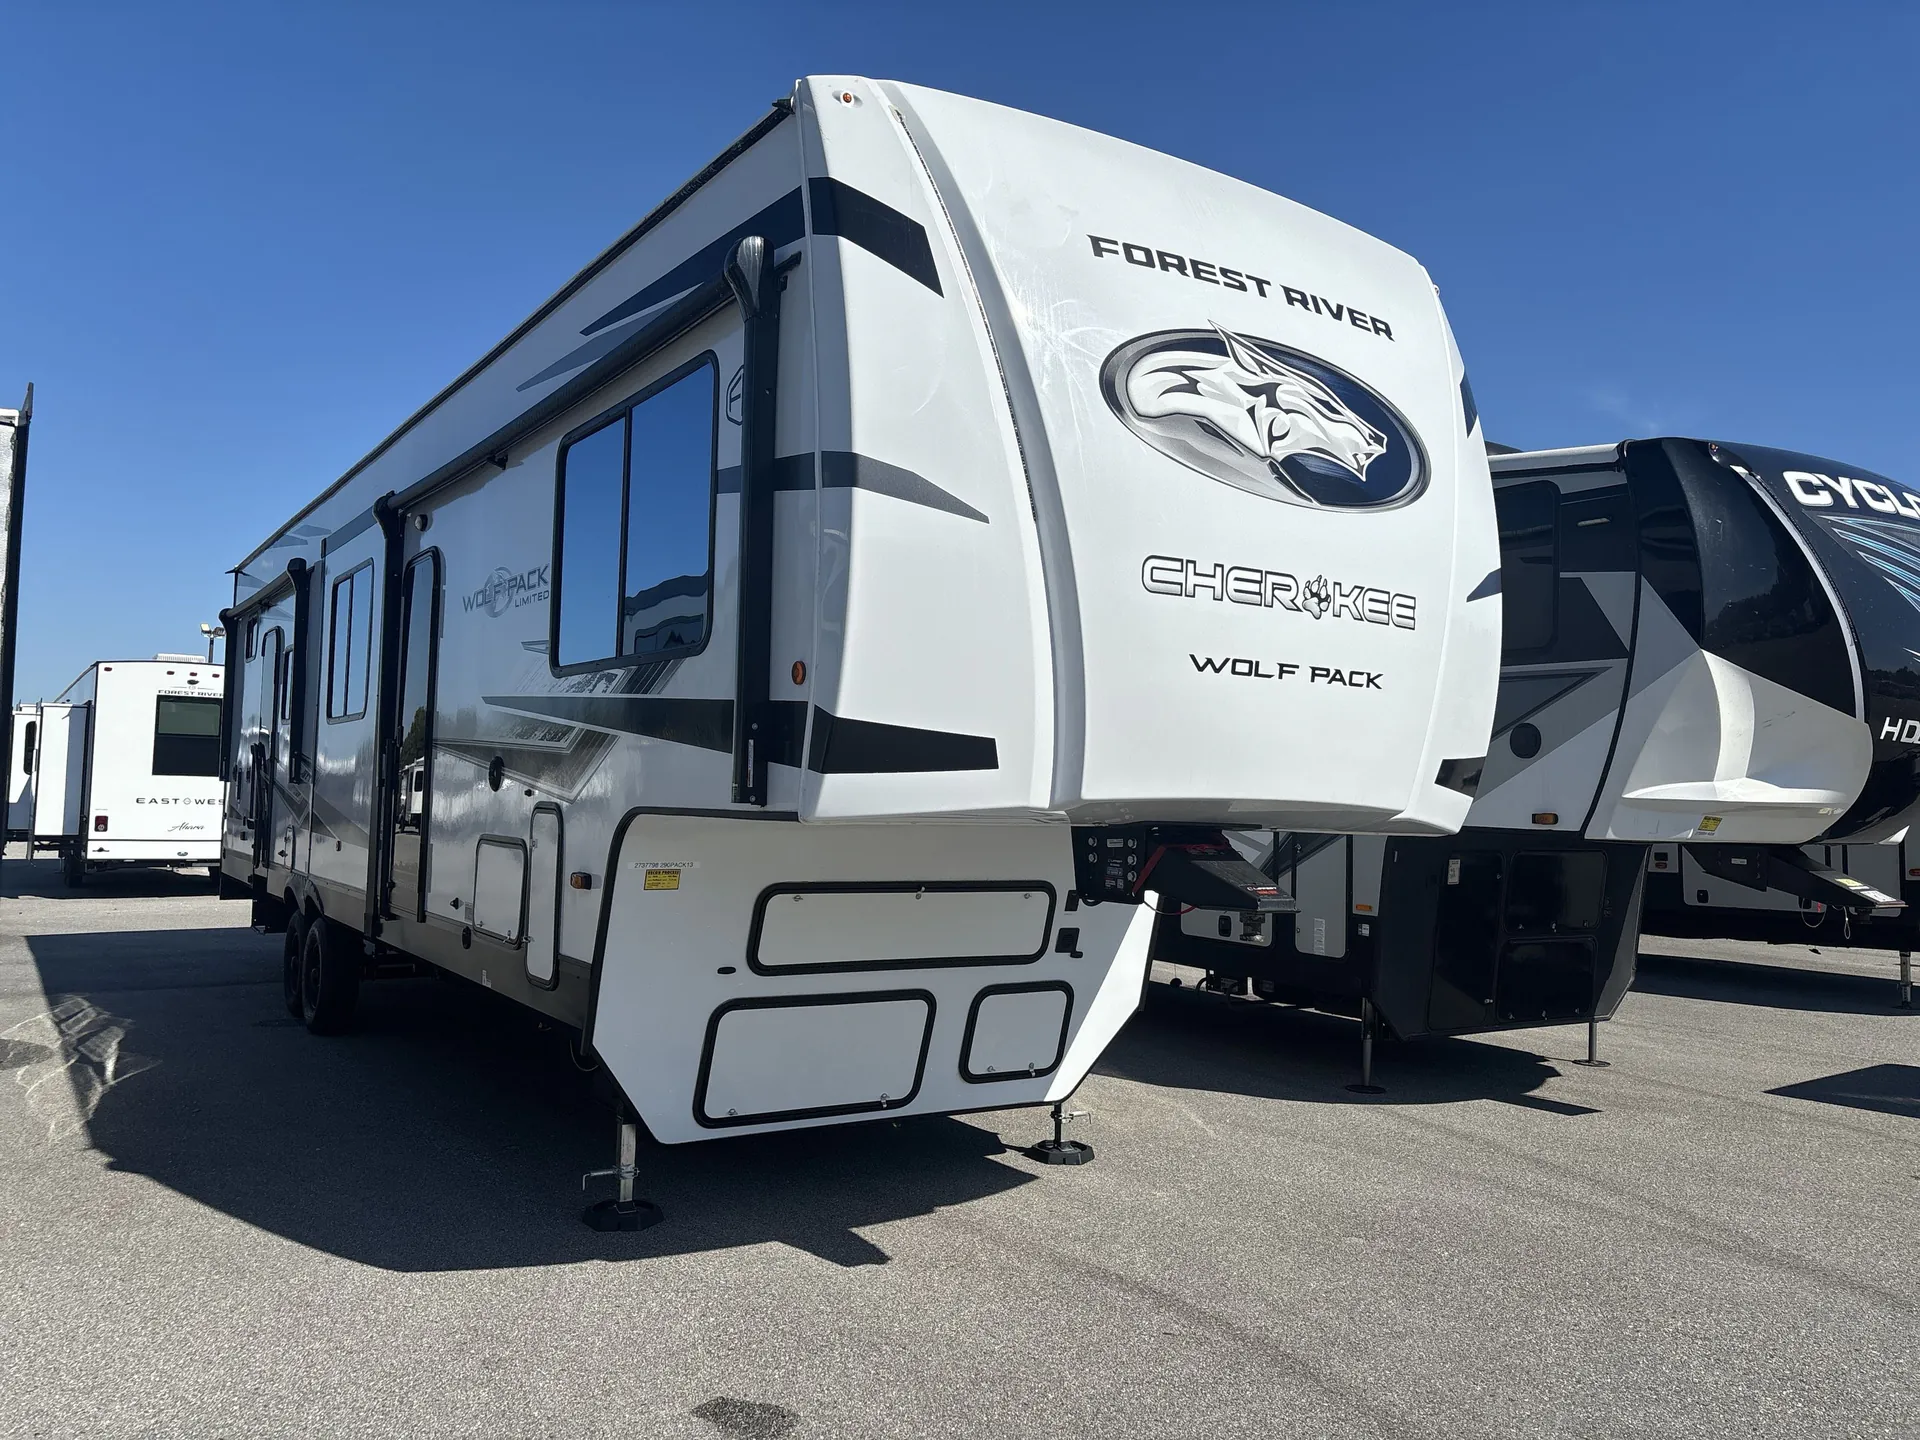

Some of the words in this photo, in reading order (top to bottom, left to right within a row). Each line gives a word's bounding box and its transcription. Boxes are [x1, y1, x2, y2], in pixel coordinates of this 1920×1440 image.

[1086, 234, 1271, 298] FOREST
[1279, 284, 1395, 342] RIVER
[514, 590, 550, 608] LIMITED
[1142, 555, 1416, 631] CHEROKEE
[1189, 653, 1299, 680] WOLF
[1308, 665, 1384, 690] PACK
[1880, 716, 1920, 745] HD
